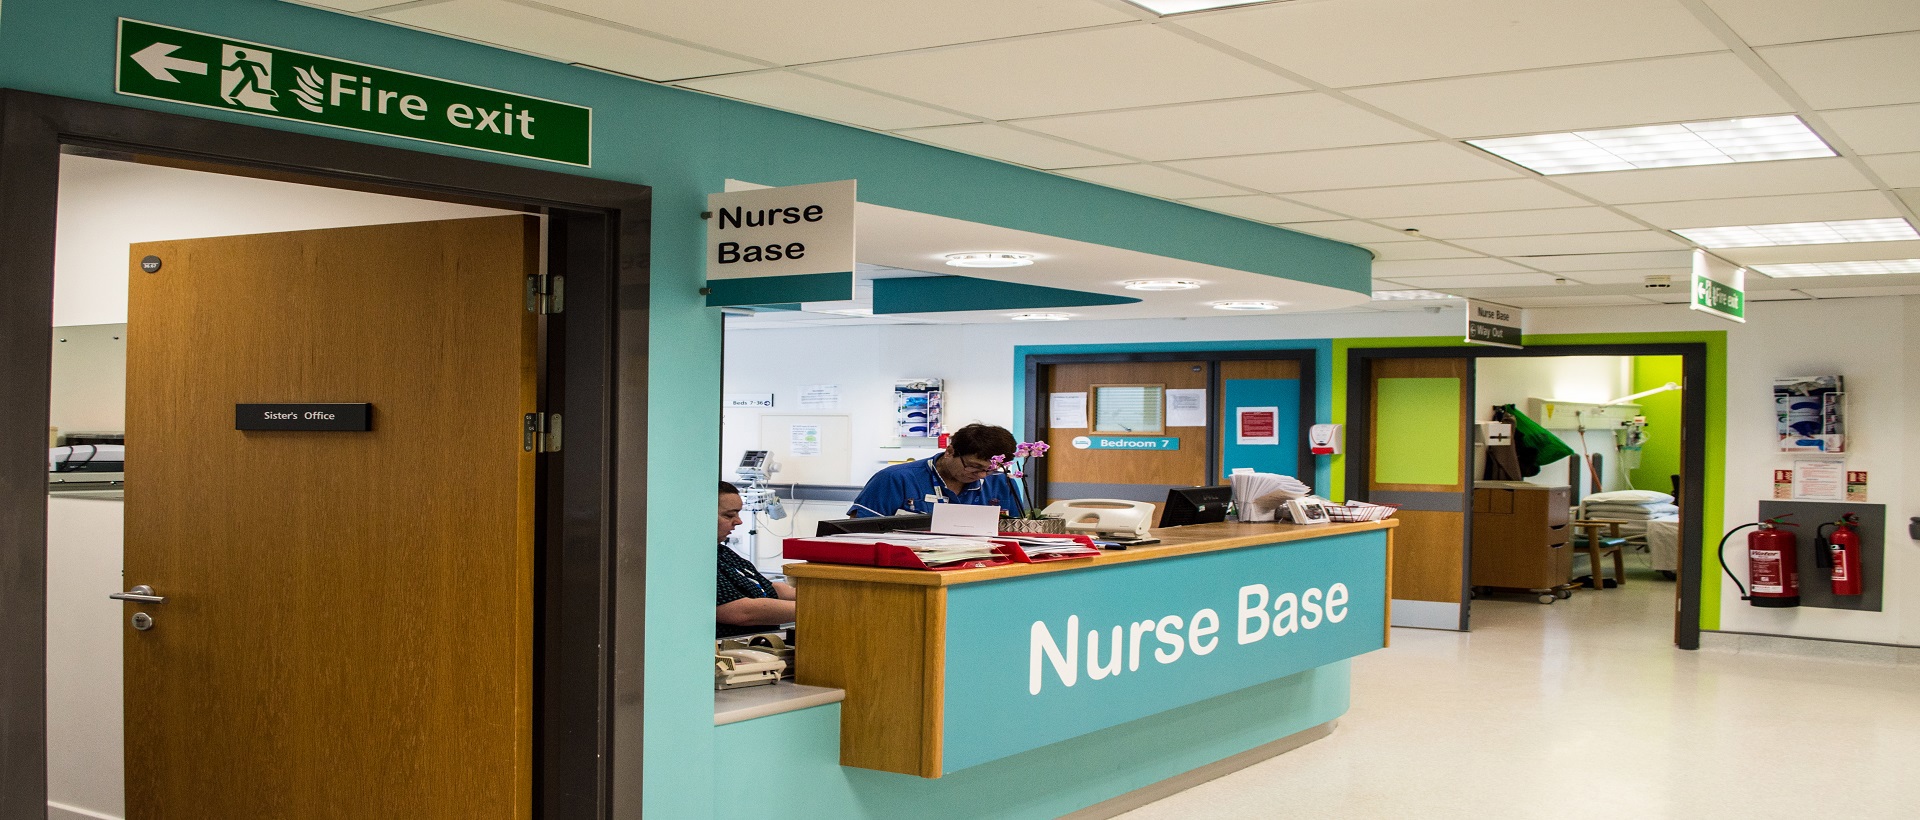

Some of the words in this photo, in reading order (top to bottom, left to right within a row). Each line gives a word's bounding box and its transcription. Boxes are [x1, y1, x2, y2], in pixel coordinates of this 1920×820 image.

[330, 72, 428, 121] Fire
[447, 103, 535, 140] exit
[719, 204, 823, 230] Nurse
[718, 241, 805, 264] Base
[1477, 306, 1495, 319] Nurse
[1496, 310, 1510, 321] Base
[1476, 324, 1490, 338] Way
[1492, 327, 1504, 338] Out
[264, 411, 298, 420] Sister's
[304, 411, 335, 420] Office
[1100, 439, 1157, 448] Bedroom
[1161, 440, 1170, 448] 7
[1029, 608, 1220, 696] Nurse
[1237, 582, 1349, 645] Base
